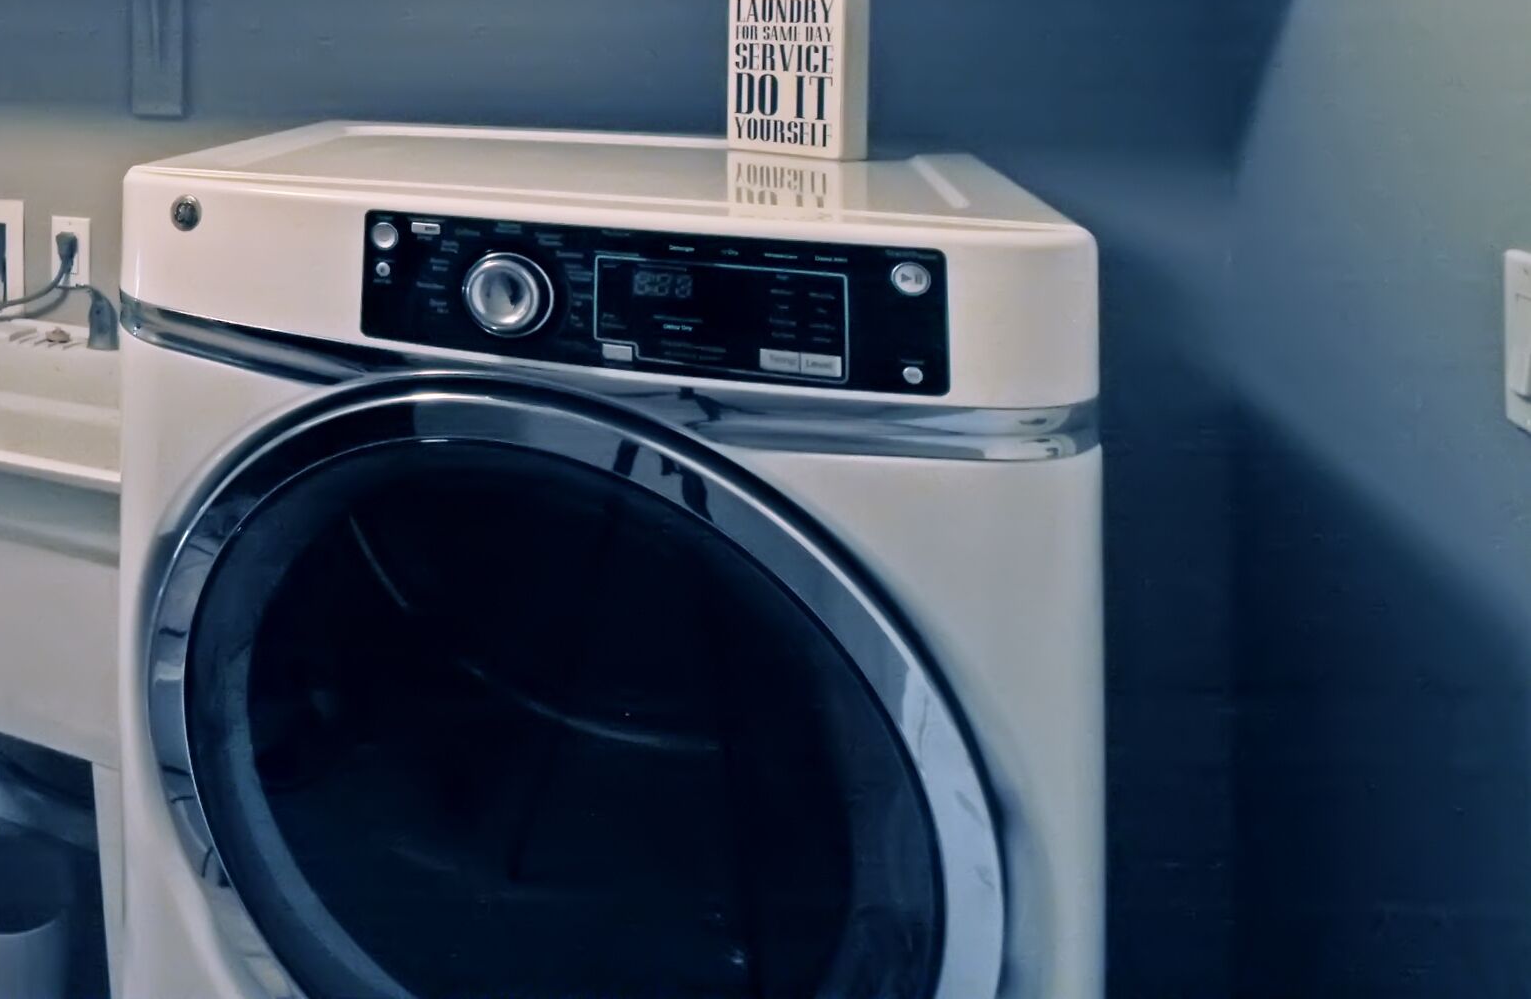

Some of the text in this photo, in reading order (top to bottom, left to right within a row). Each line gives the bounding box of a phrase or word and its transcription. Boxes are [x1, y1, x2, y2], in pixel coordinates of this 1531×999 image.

[736, 25, 834, 42] FOR SAME DAY
[735, 42, 834, 74] SERVICE
[735, 72, 833, 120] DO IT
[734, 116, 833, 148] YOURSELF
